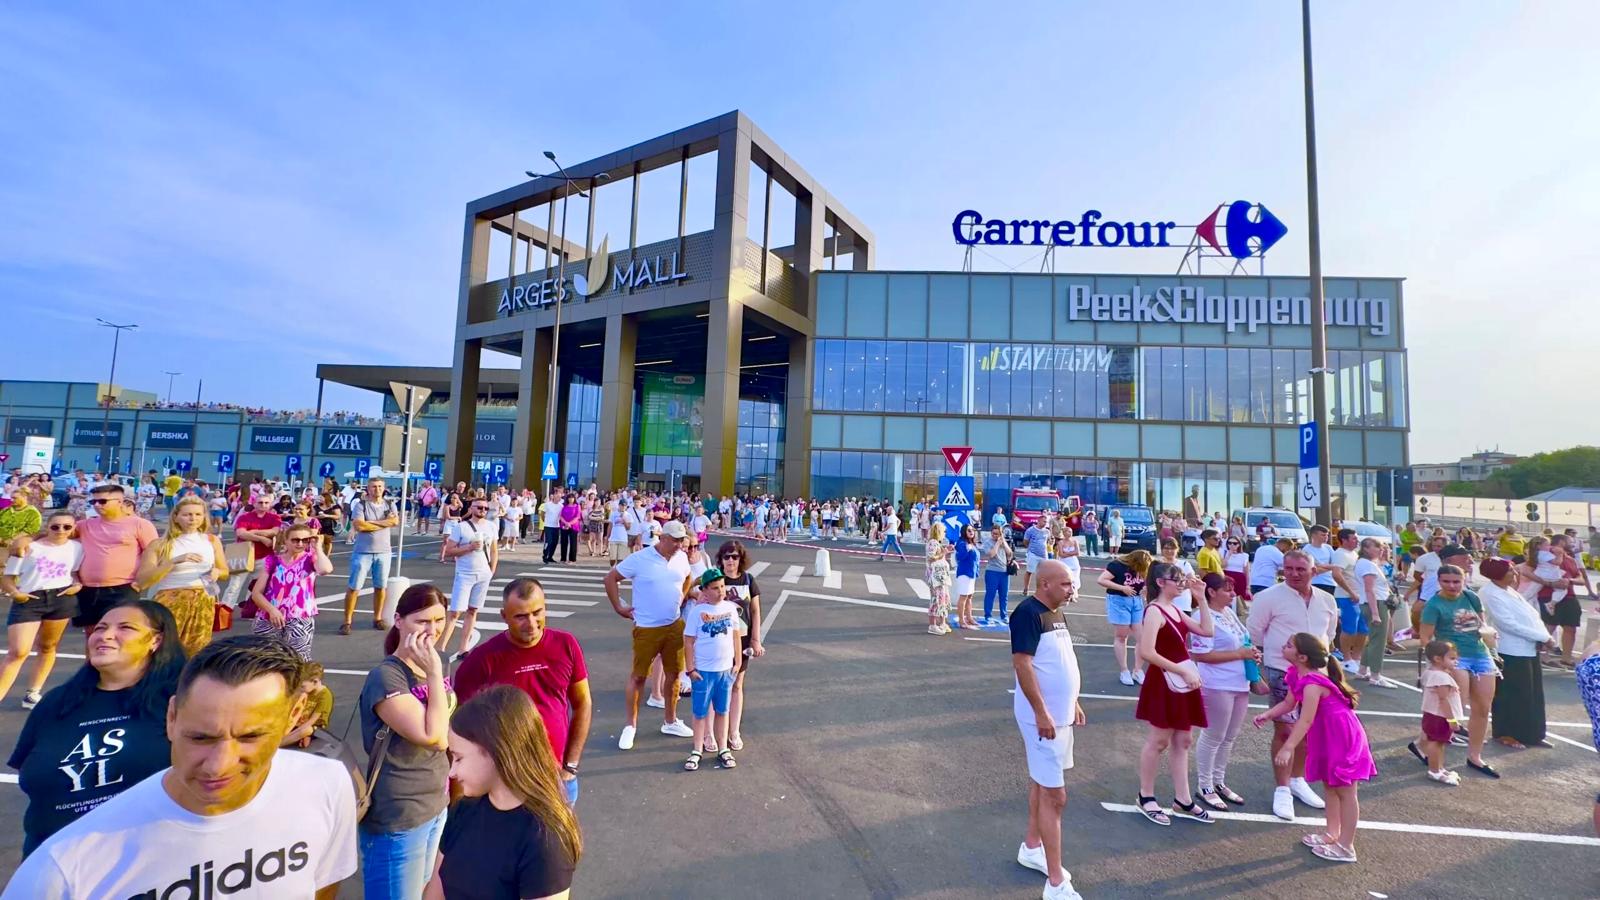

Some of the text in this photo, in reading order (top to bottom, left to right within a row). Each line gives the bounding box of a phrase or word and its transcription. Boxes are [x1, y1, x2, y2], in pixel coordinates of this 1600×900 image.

[952, 209, 1176, 247] Carrefour
[497, 251, 687, 313] ARGES MALL
[1069, 284, 1391, 336] Peek&Cloppenurg
[151, 431, 189, 440] BERSHKA
[255, 435, 294, 444] PULL&BEAR
[327, 433, 362, 451] ZARA
[1303, 427, 1313, 454] P
[222, 455, 231, 467] P
[288, 457, 298, 469] P
[358, 461, 367, 472] P
[428, 463, 437, 474] P
[494, 465, 504, 477] P
[60, 728, 126, 763] AS
[58, 758, 124, 792] YL
[56, 794, 119, 810] FLÜCHTLINGSPROJ
